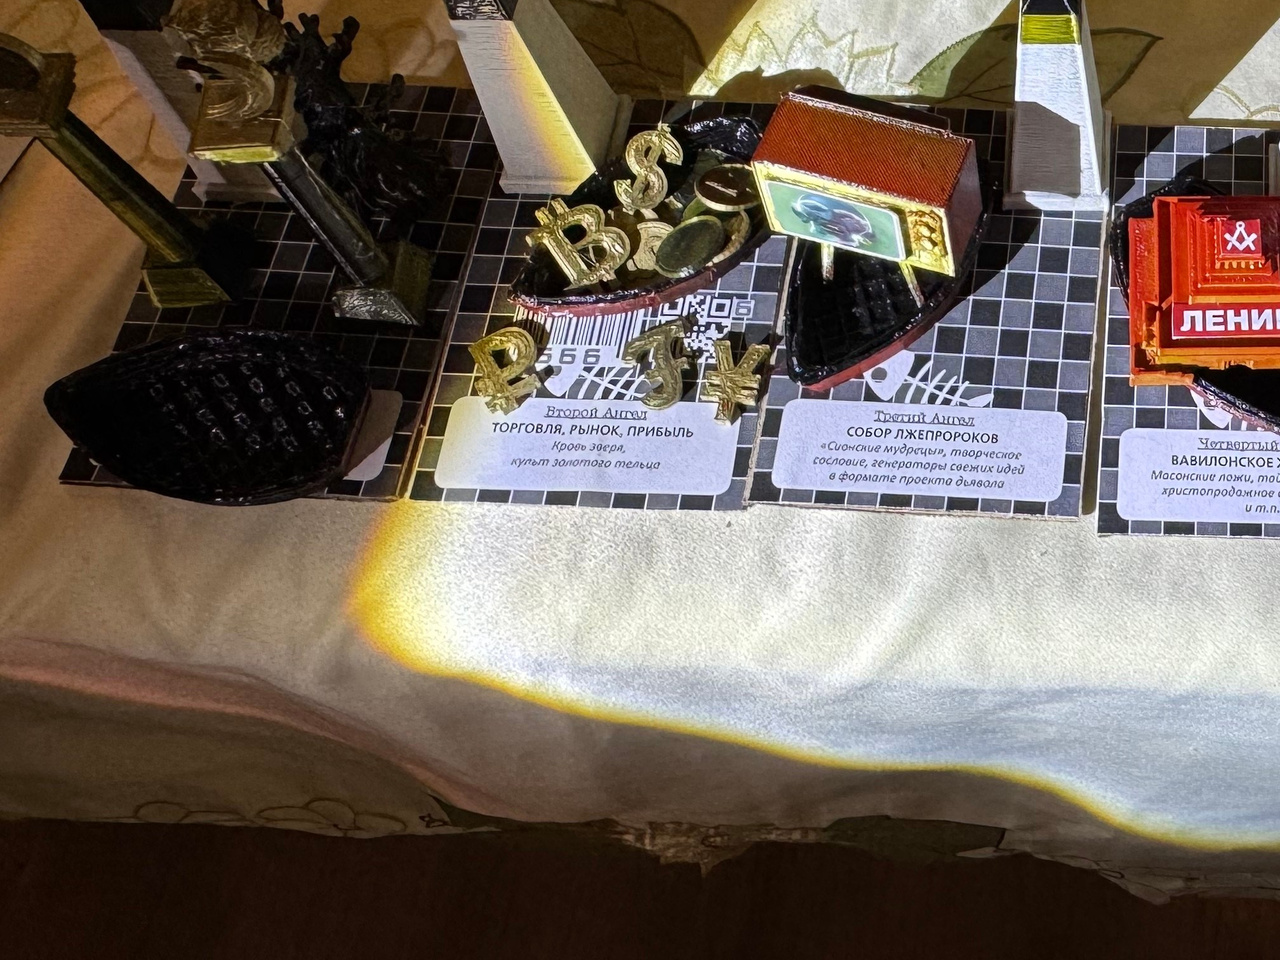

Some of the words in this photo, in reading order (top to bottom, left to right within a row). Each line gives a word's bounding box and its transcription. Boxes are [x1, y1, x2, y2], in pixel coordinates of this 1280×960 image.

[544, 405, 599, 420] Второй
[602, 406, 648, 421] Ангел
[491, 421, 566, 436] ТОРГОВЛЯ,
[569, 424, 623, 438] РЫНОК,
[626, 425, 694, 438] ПРИБЫЛЬ
[846, 426, 893, 440] СОБОР
[894, 428, 999, 444] ЛЖЕПРОРОКОВ
[950, 448, 1023, 461] творческое
[1171, 454, 1274, 469] ВАВИЛОНСКОЕ
[813, 456, 869, 468] сословие,
[870, 458, 948, 473] генераторы
[950, 462, 994, 474] свежих
[996, 462, 1025, 476] идей
[828, 471, 837, 481] в
[838, 470, 897, 485] формате
[898, 473, 953, 487] проекта
[955, 475, 1005, 489] дьявола
[1150, 470, 1216, 482] Масонские
[1218, 472, 1254, 484] ложи,
[1161, 485, 1276, 499] христопродажное
[1245, 504, 1253, 513] и
[1254, 504, 1280, 514] т.п.
